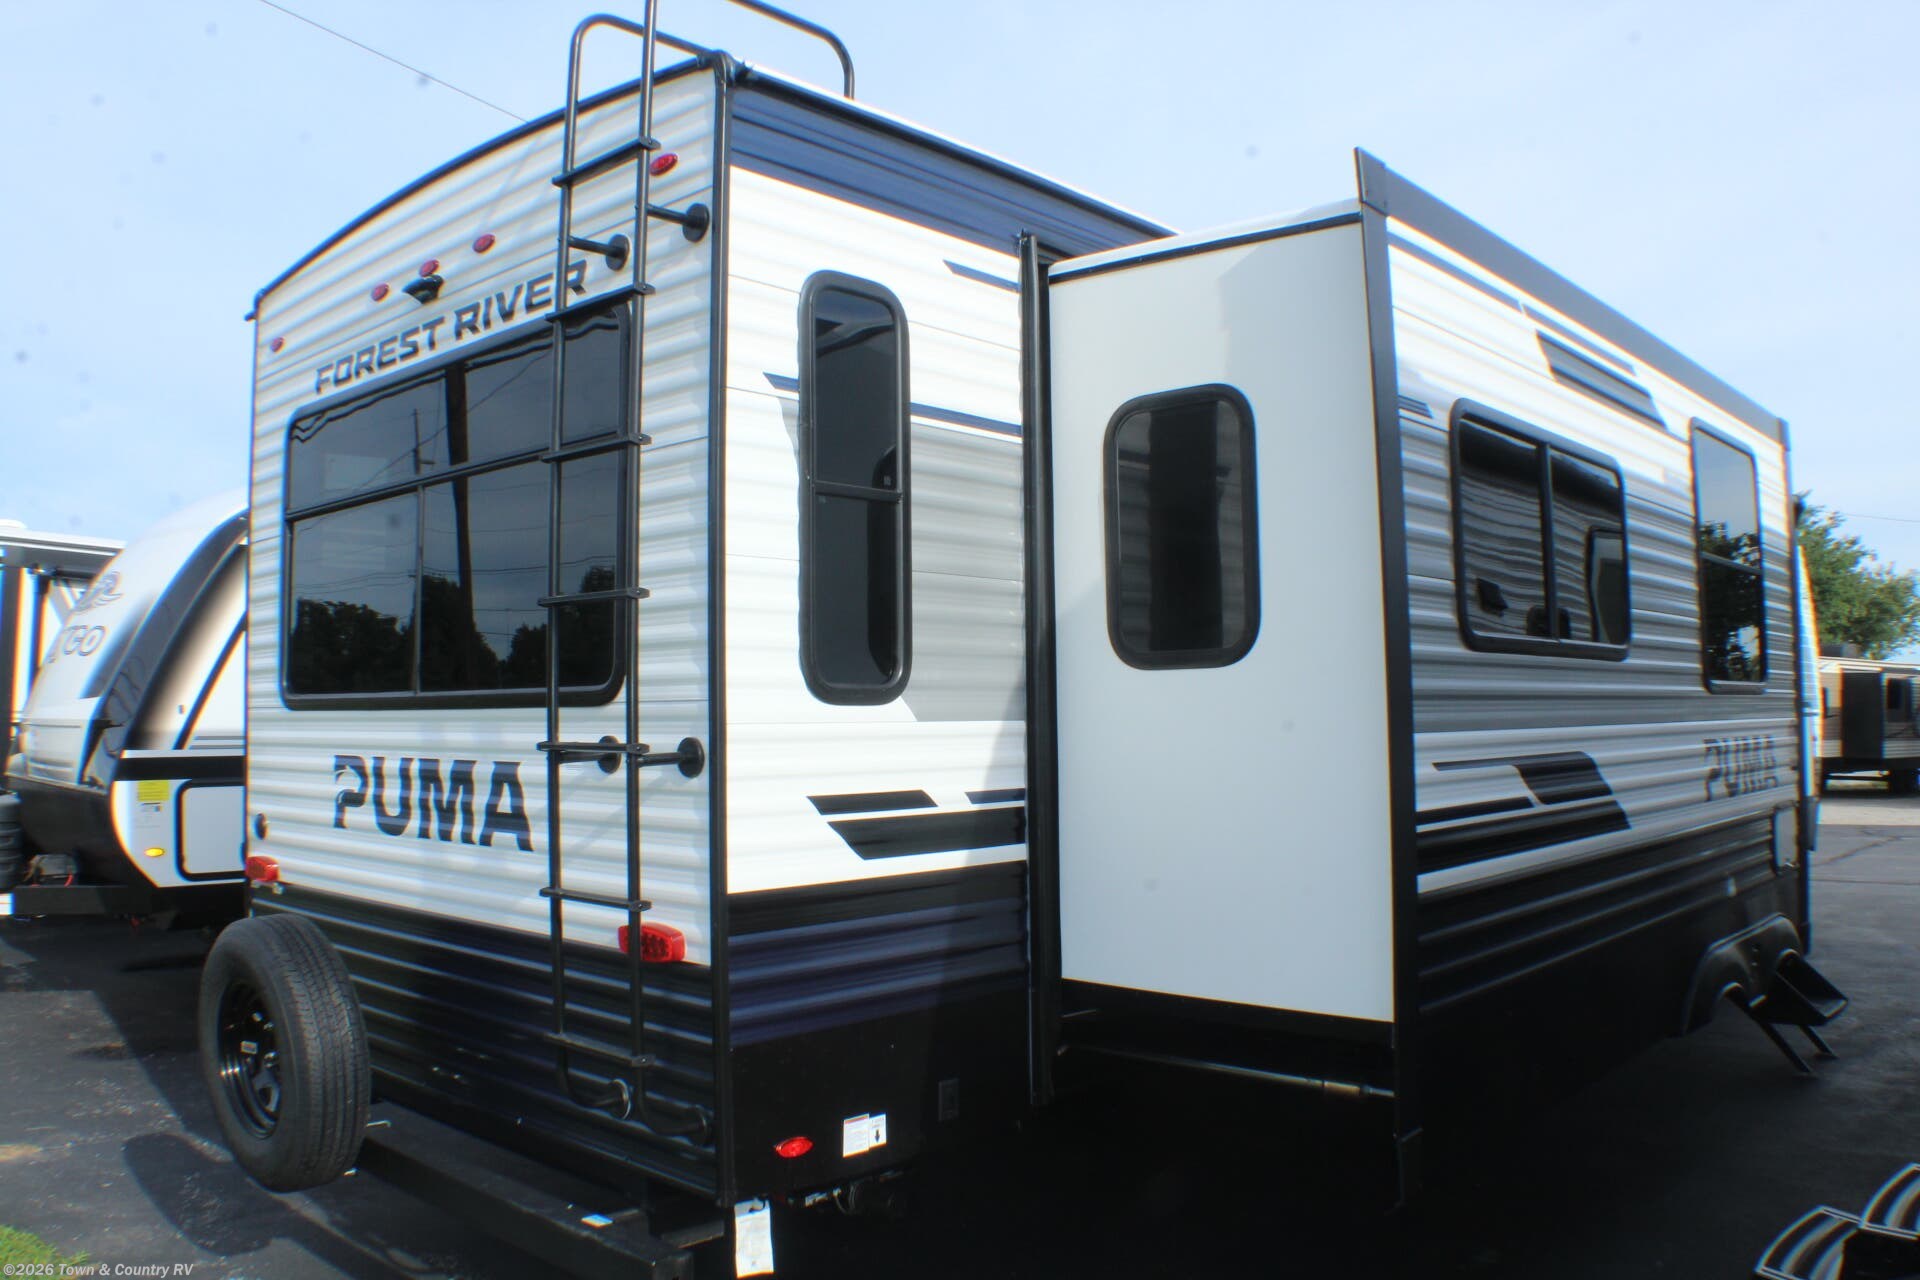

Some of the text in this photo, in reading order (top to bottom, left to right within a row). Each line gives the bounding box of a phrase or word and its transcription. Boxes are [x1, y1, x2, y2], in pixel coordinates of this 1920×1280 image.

[315, 259, 588, 395] FOREST RIVER
[334, 754, 535, 853] PUMA
